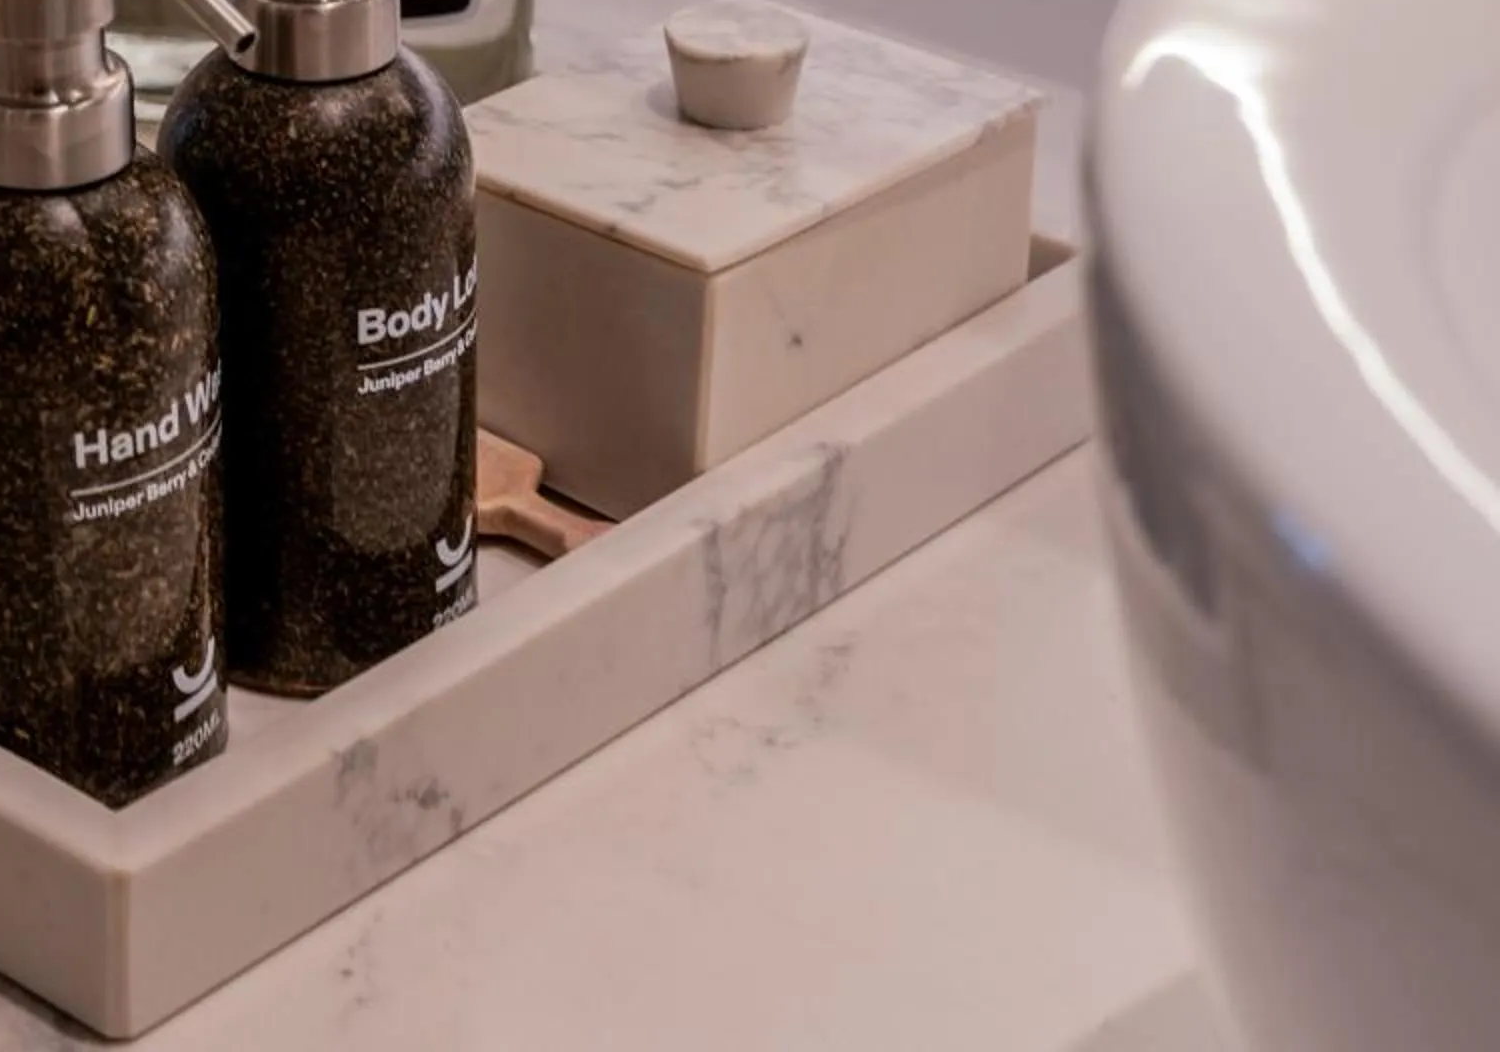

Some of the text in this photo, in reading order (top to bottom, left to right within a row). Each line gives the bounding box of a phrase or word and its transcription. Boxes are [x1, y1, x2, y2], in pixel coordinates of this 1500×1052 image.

[357, 291, 449, 346] Body
[453, 252, 478, 311] Lo
[357, 367, 422, 395] Juniper
[423, 348, 458, 376] Berry
[73, 399, 179, 470] Hand
[72, 491, 145, 522] Juniper
[146, 469, 187, 502] Berry
